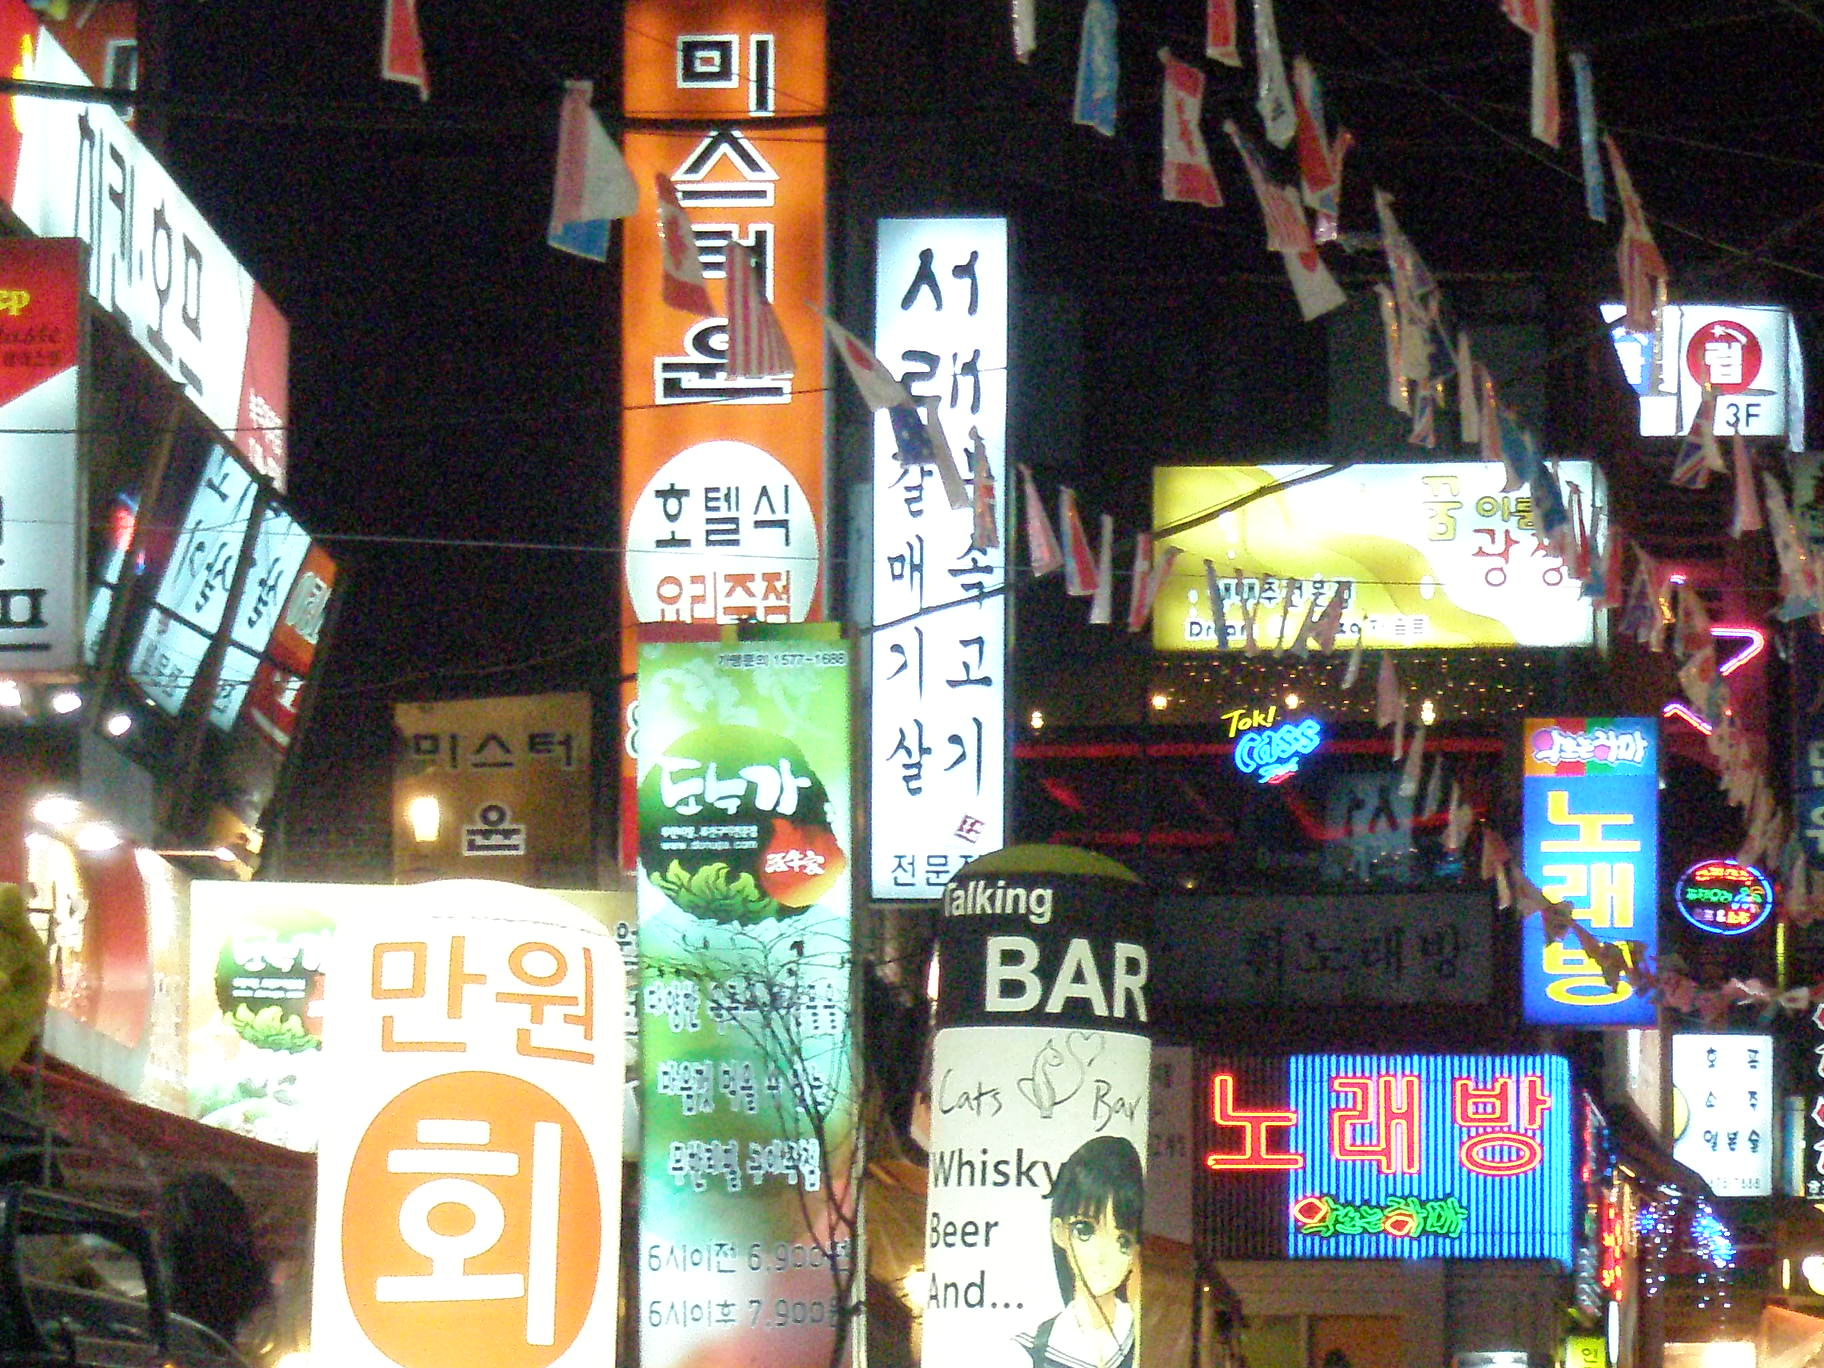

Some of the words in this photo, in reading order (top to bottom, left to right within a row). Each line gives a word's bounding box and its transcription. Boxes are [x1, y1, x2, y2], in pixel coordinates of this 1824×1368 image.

[900, 248, 980, 415] 서래
[1726, 403, 1762, 427] 3F
[655, 483, 791, 548] 호텔식
[413, 732, 574, 768] 미스터
[1235, 719, 1322, 773] Cass
[1540, 791, 1641, 1005] 노래방
[372, 936, 596, 1065] 만원
[985, 936, 1148, 1022] BAR
[1206, 1073, 1551, 1175] 노래방
[931, 1148, 1061, 1198] Whisky
[376, 1119, 562, 1345] 회
[648, 1243, 737, 1273] 6시이전
[929, 1212, 999, 1248] Beer
[649, 1299, 737, 1328] 6시이후
